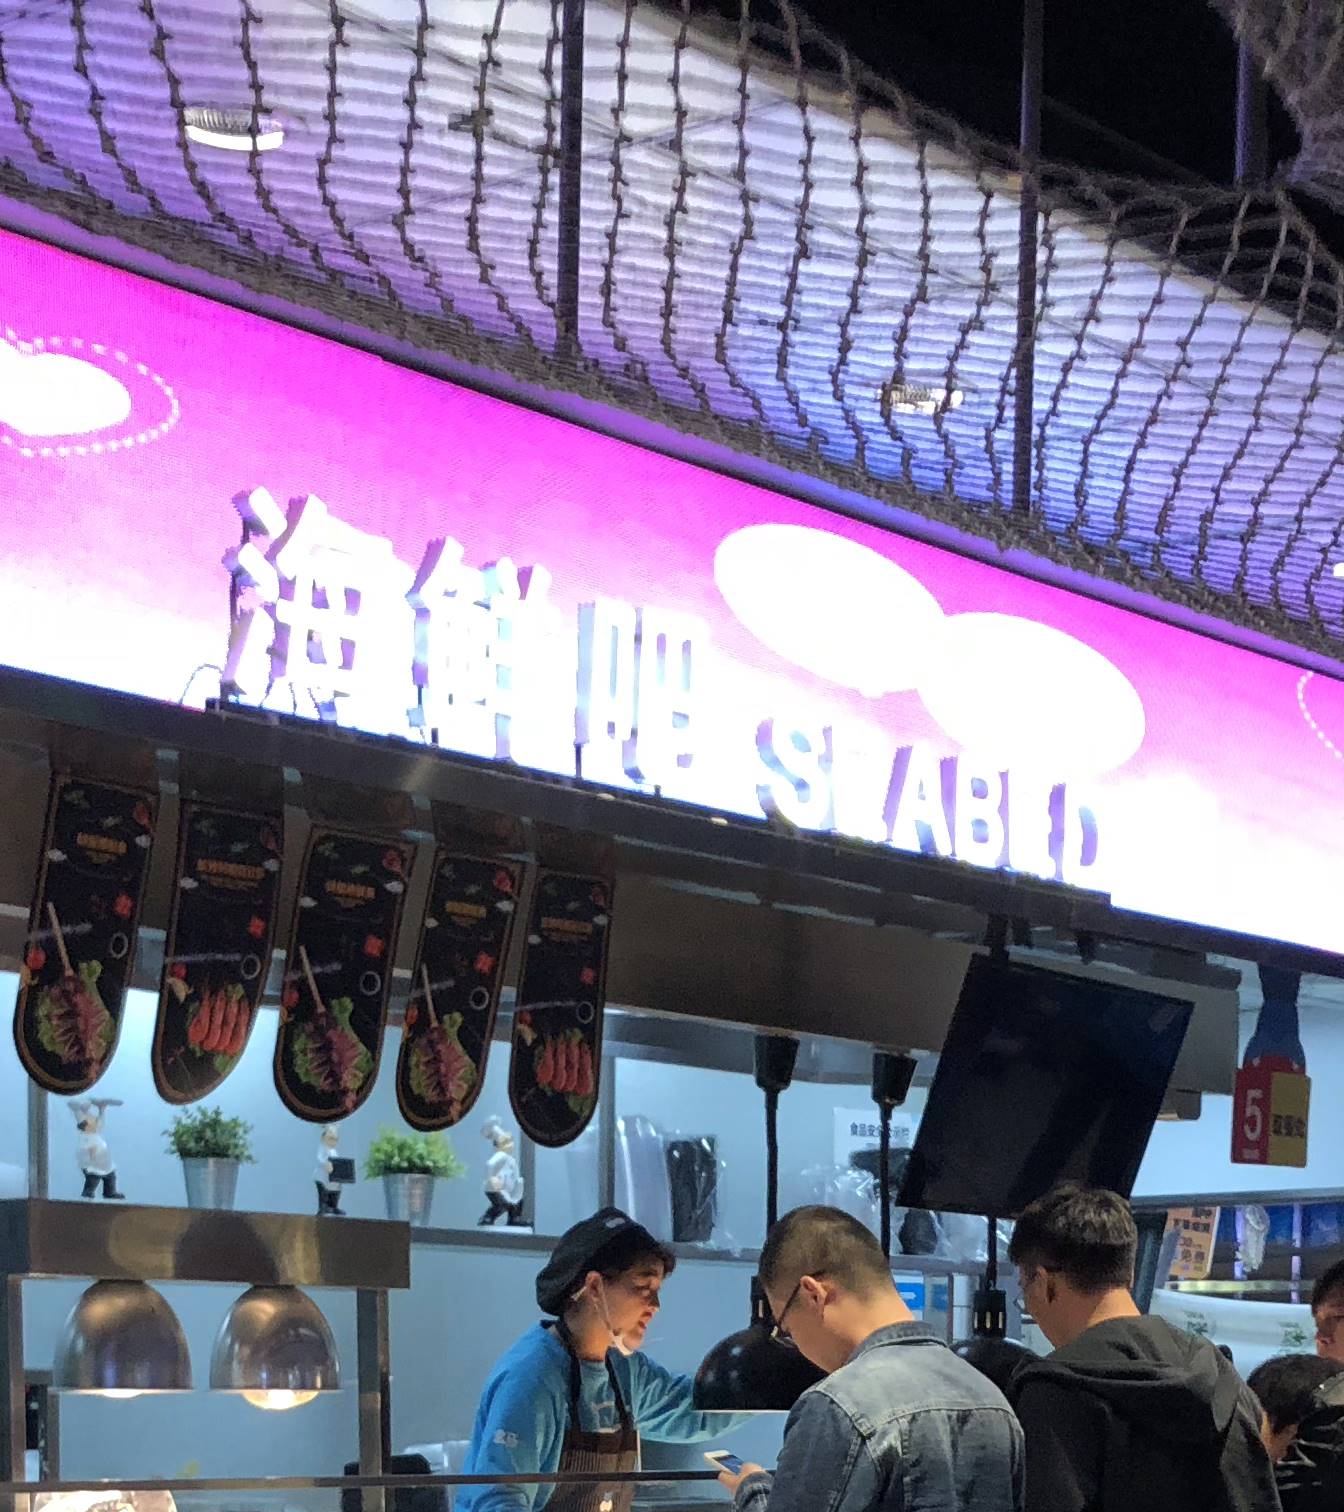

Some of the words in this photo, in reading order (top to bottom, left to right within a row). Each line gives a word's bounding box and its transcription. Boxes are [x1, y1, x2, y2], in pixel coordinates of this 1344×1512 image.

[228, 485, 716, 794] 海鲜吧
[850, 1121, 910, 1138] 食品安全示栏
[1244, 1088, 1263, 1142] 5
